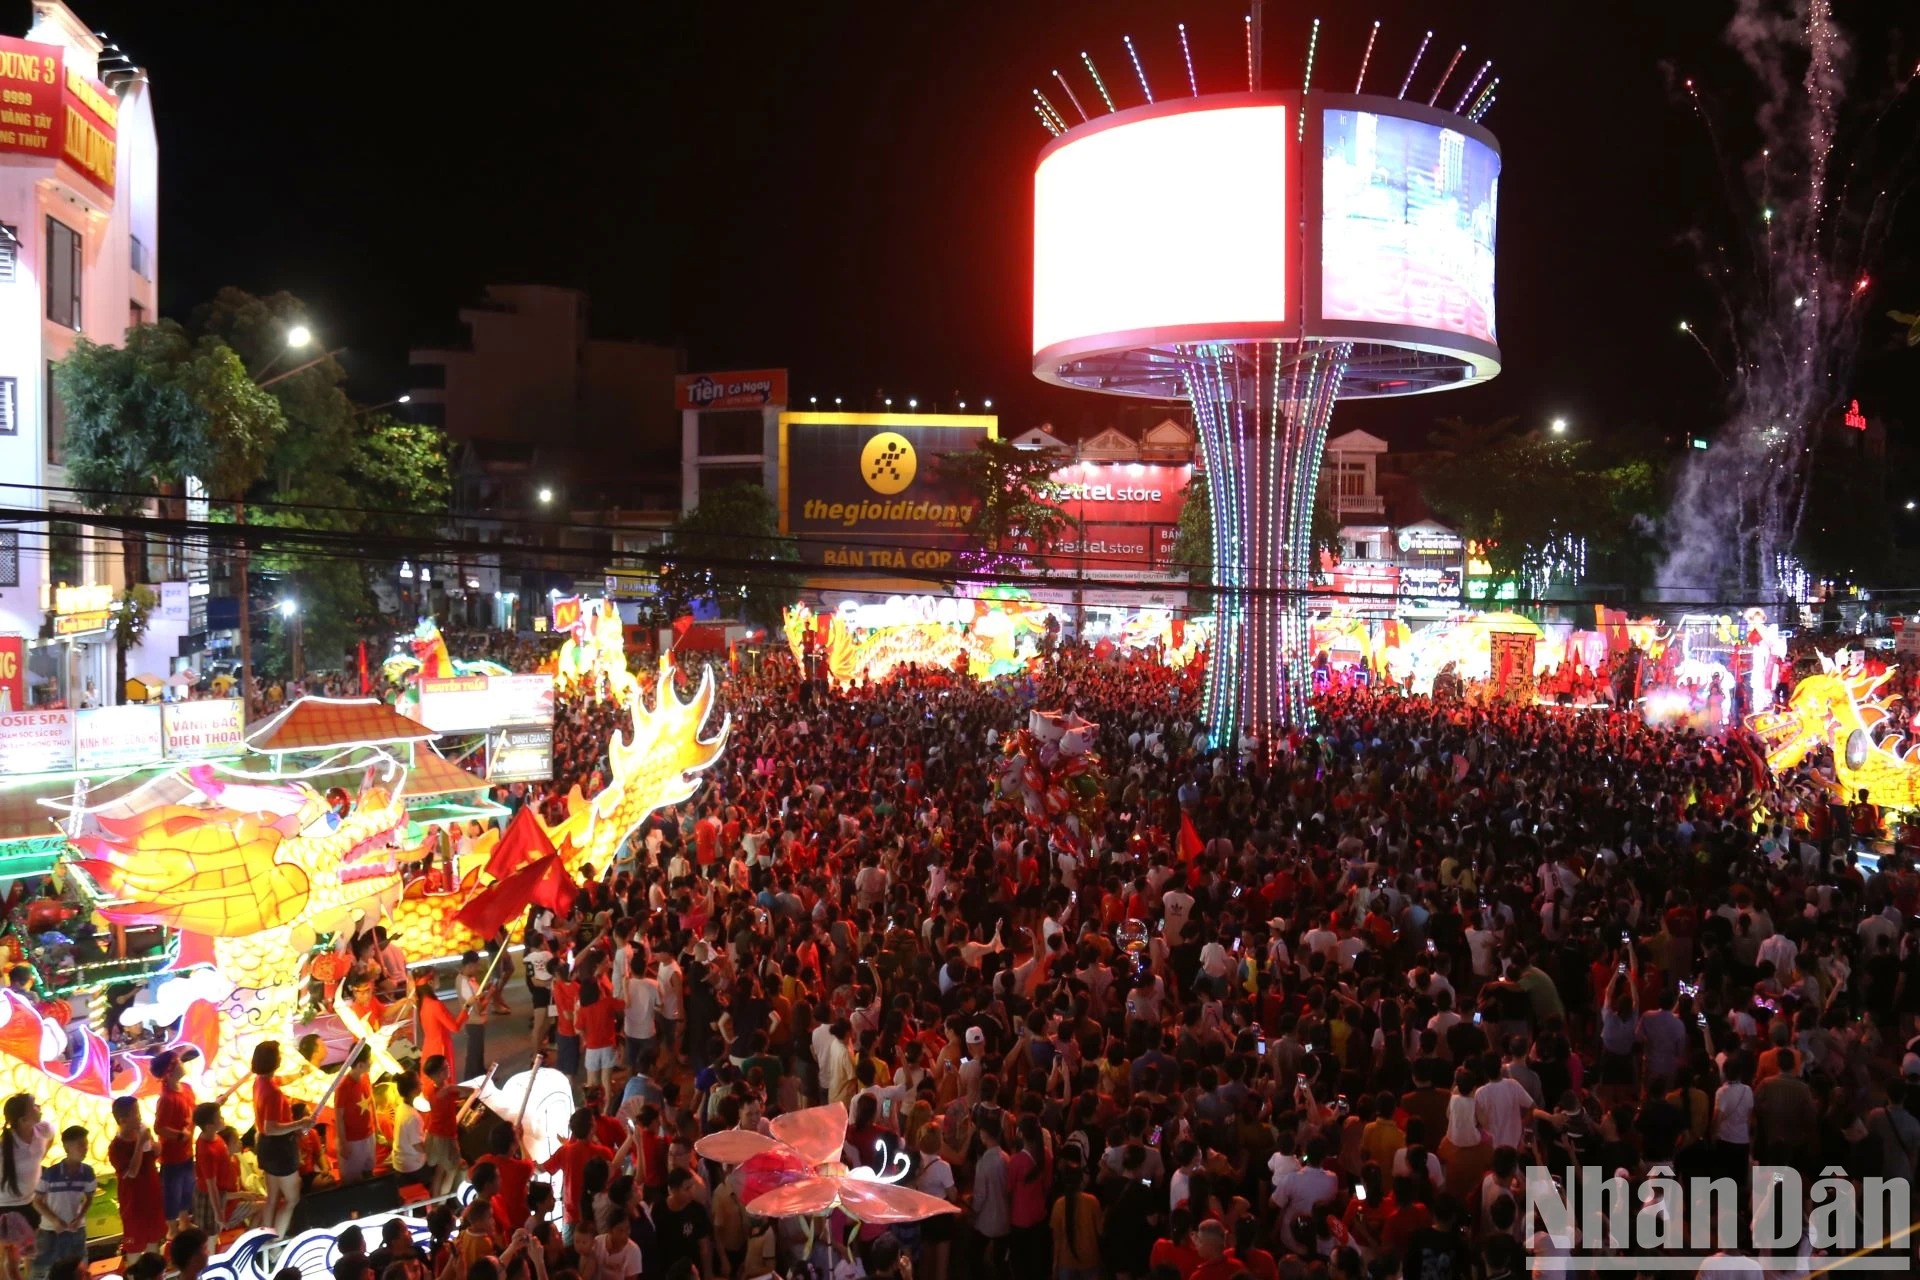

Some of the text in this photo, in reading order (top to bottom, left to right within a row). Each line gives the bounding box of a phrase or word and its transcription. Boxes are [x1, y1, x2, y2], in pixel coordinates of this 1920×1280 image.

[43, 57, 55, 84] 3
[2, 89, 32, 106] 9999
[687, 378, 724, 402] Tiền
[1117, 486, 1161, 502] store
[804, 499, 973, 527] thegioididong
[823, 546, 863, 567] BÁN
[1109, 542, 1144, 554] store
[39, 713, 68, 725] SPA
